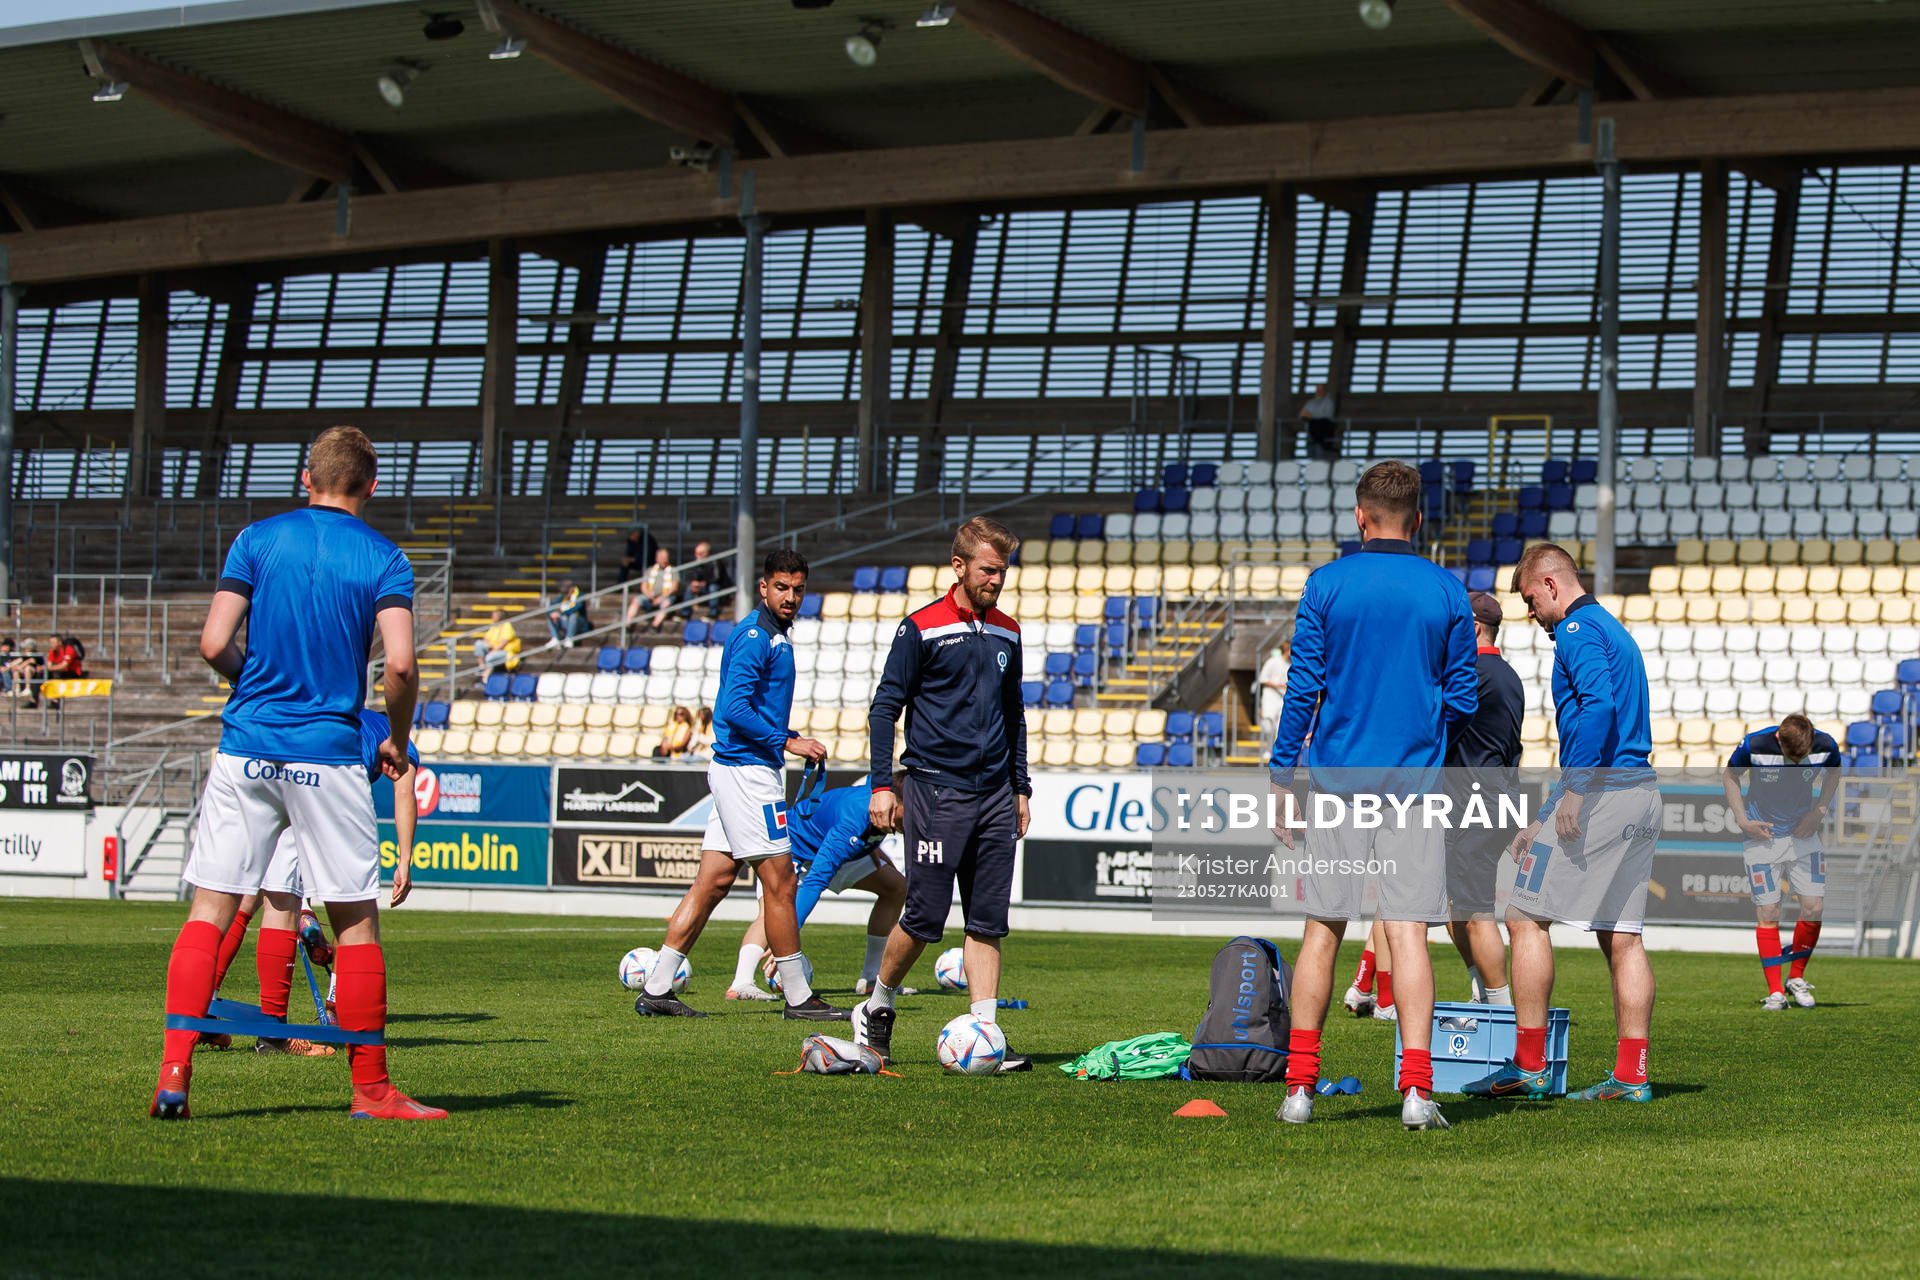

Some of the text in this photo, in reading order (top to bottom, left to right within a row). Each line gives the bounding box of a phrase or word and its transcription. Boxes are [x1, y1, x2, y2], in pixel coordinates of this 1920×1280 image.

[24, 762, 48, 782] IT,
[243, 758, 320, 787] Corren
[23, 784, 48, 804] IT!
[1065, 782, 1231, 833] GleSYS
[379, 832, 519, 872] semblin
[583, 842, 632, 876] XL
[917, 840, 943, 864] PH
[655, 861, 700, 878] VARB
[1231, 952, 1258, 1041] uhlsport
[1636, 1048, 1647, 1077] Kempa
